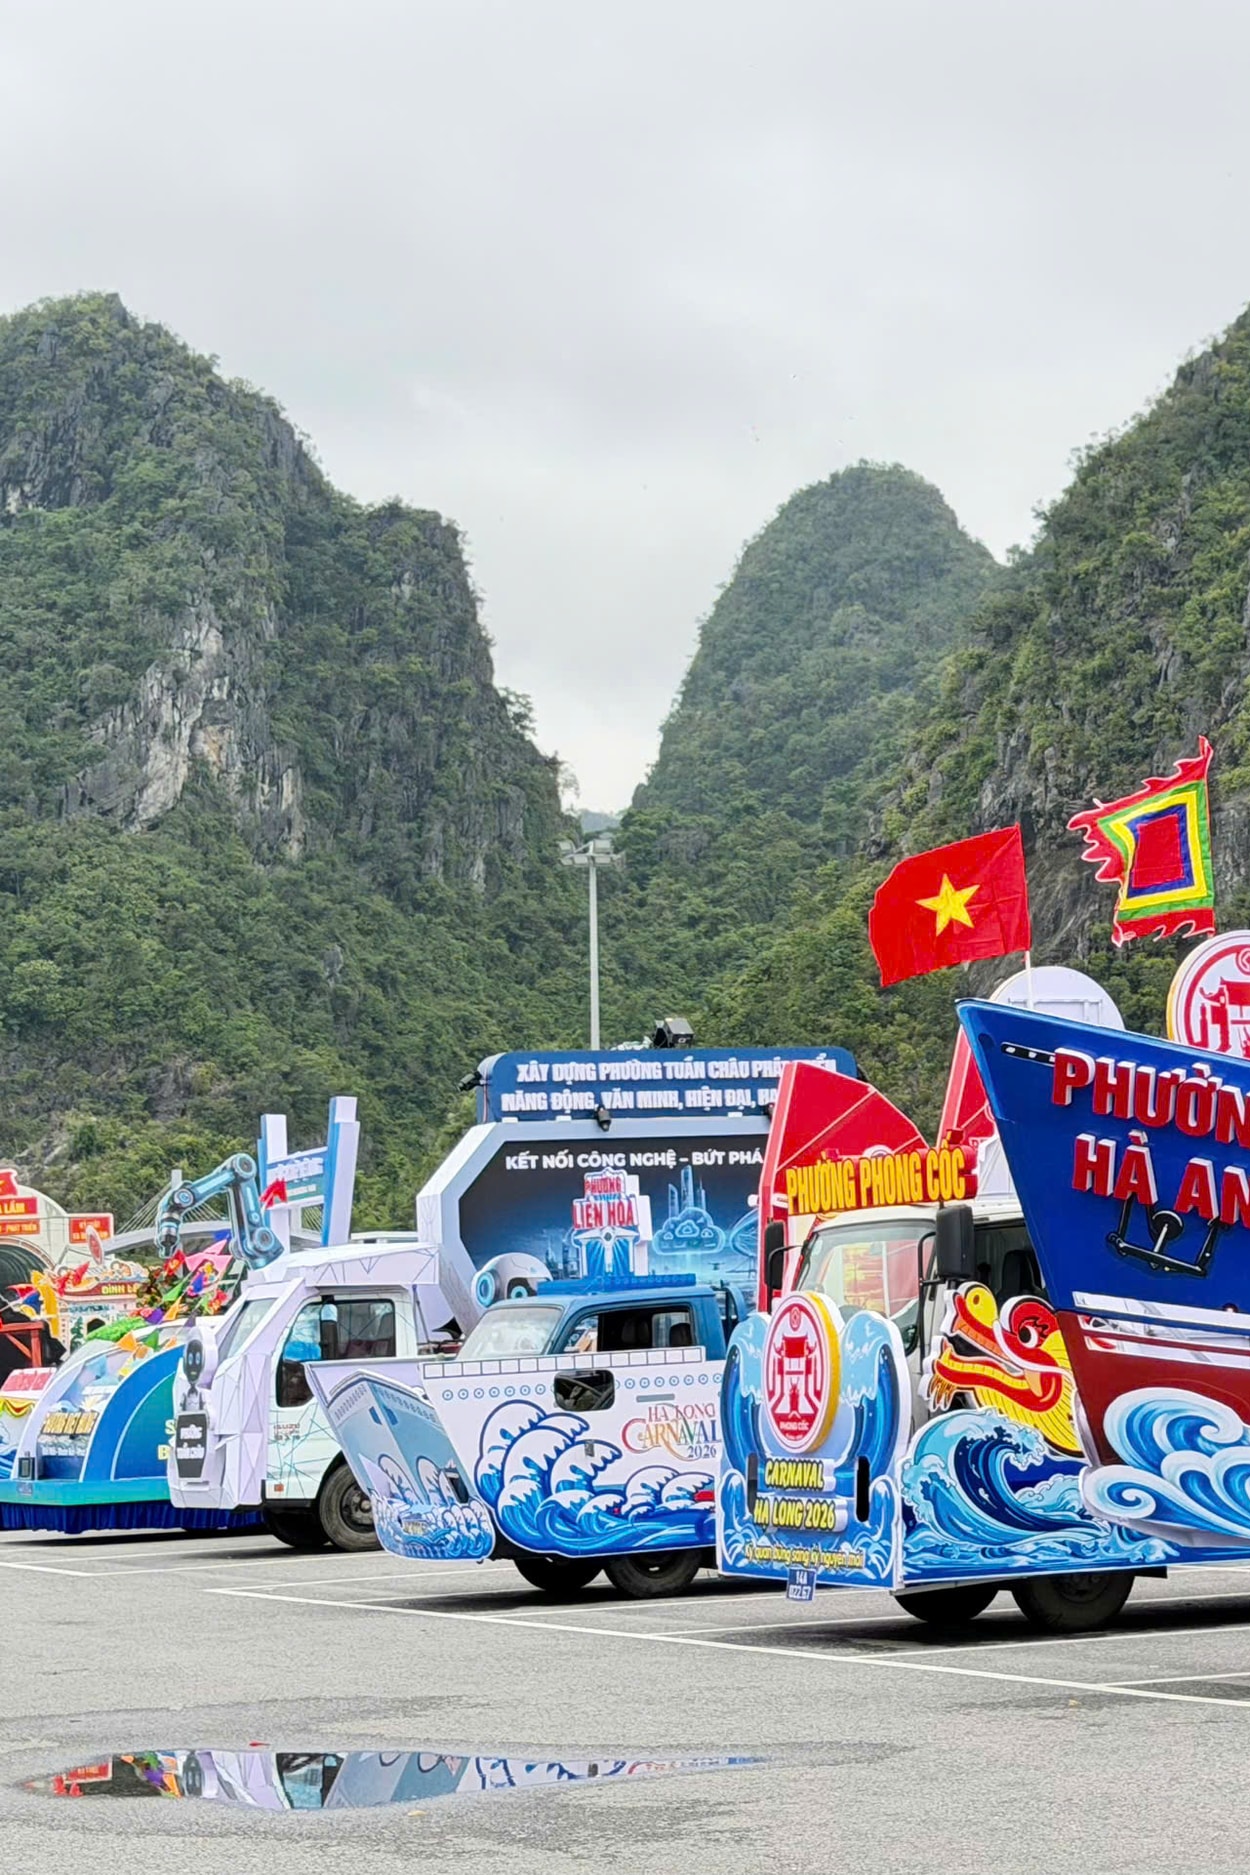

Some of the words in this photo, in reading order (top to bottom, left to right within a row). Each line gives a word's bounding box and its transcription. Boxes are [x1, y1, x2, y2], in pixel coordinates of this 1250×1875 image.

[516, 1060, 550, 1083] XÂY
[552, 1062, 597, 1085] DỰNG
[599, 1059, 663, 1080] PHƯỜNG
[708, 1057, 750, 1079] CHÂU
[501, 1090, 548, 1112] NĂNG
[601, 1088, 635, 1110] VĂN
[685, 1086, 722, 1111] HIỆN
[505, 1151, 538, 1170] KẾT
[542, 1150, 574, 1169] NỐI
[576, 1151, 626, 1168] CÔNG
[630, 1149, 677, 1169] NGHỆ
[692, 1149, 725, 1166] BỨT
[729, 1148, 764, 1165] PHÁ
[785, 1151, 856, 1215] PHƯỜNG
[859, 1151, 923, 1207] PHONG
[926, 1130, 966, 1201] CỐC
[1071, 1129, 1159, 1206] HÀ
[622, 1417, 722, 1462] CARNAVAL
[687, 1445, 717, 1459] 2026
[764, 1458, 824, 1490] CARNAVAL
[754, 1498, 769, 1532] HẠ
[772, 1501, 803, 1530] LONG
[804, 1500, 835, 1530] 2026
